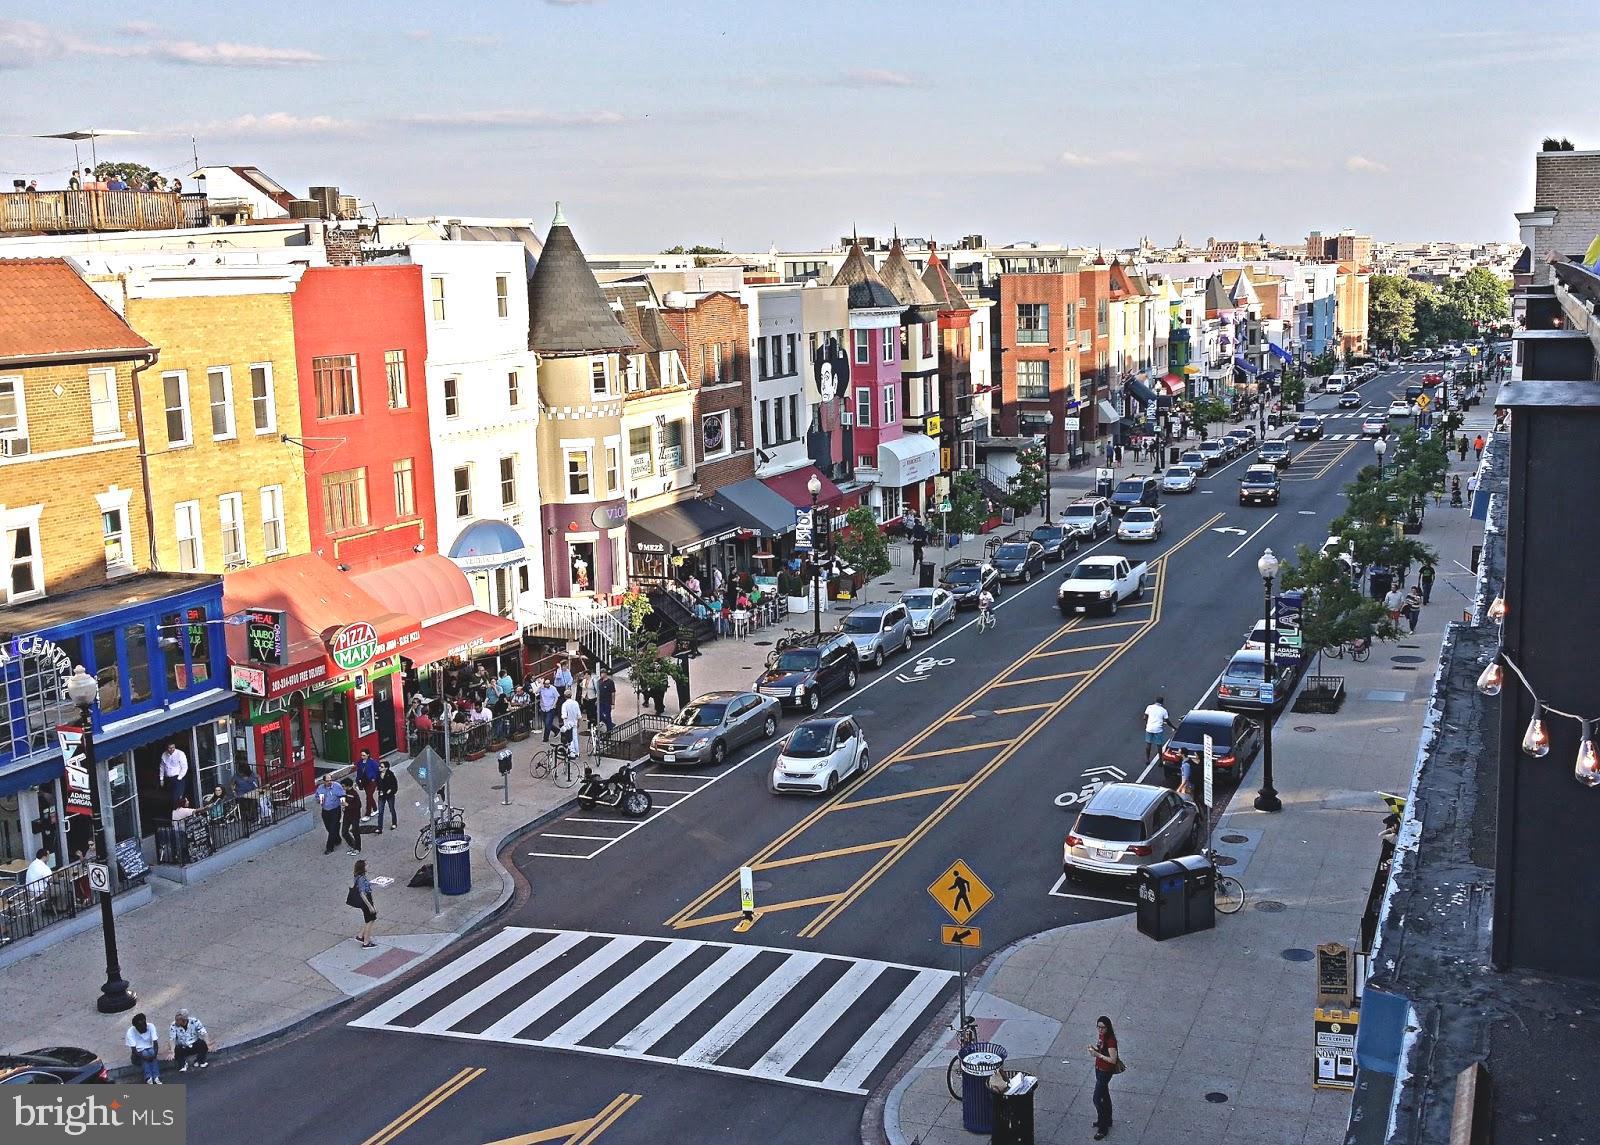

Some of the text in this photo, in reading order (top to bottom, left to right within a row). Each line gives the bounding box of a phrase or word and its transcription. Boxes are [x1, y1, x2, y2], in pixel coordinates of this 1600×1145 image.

[252, 612, 274, 624] REAL
[1278, 601, 1301, 646] PLAY
[249, 629, 275, 640] JUMBO
[339, 624, 375, 650] PIZZA
[253, 640, 275, 650] SLICE
[338, 642, 377, 666] MART
[18, 637, 76, 700] CENTRAL
[299, 670, 309, 682] FREE
[60, 732, 91, 794] EAT
[67, 797, 92, 807] MORGAN
[70, 792, 91, 801] ADAMS
[1316, 1049, 1335, 1058] NOW
